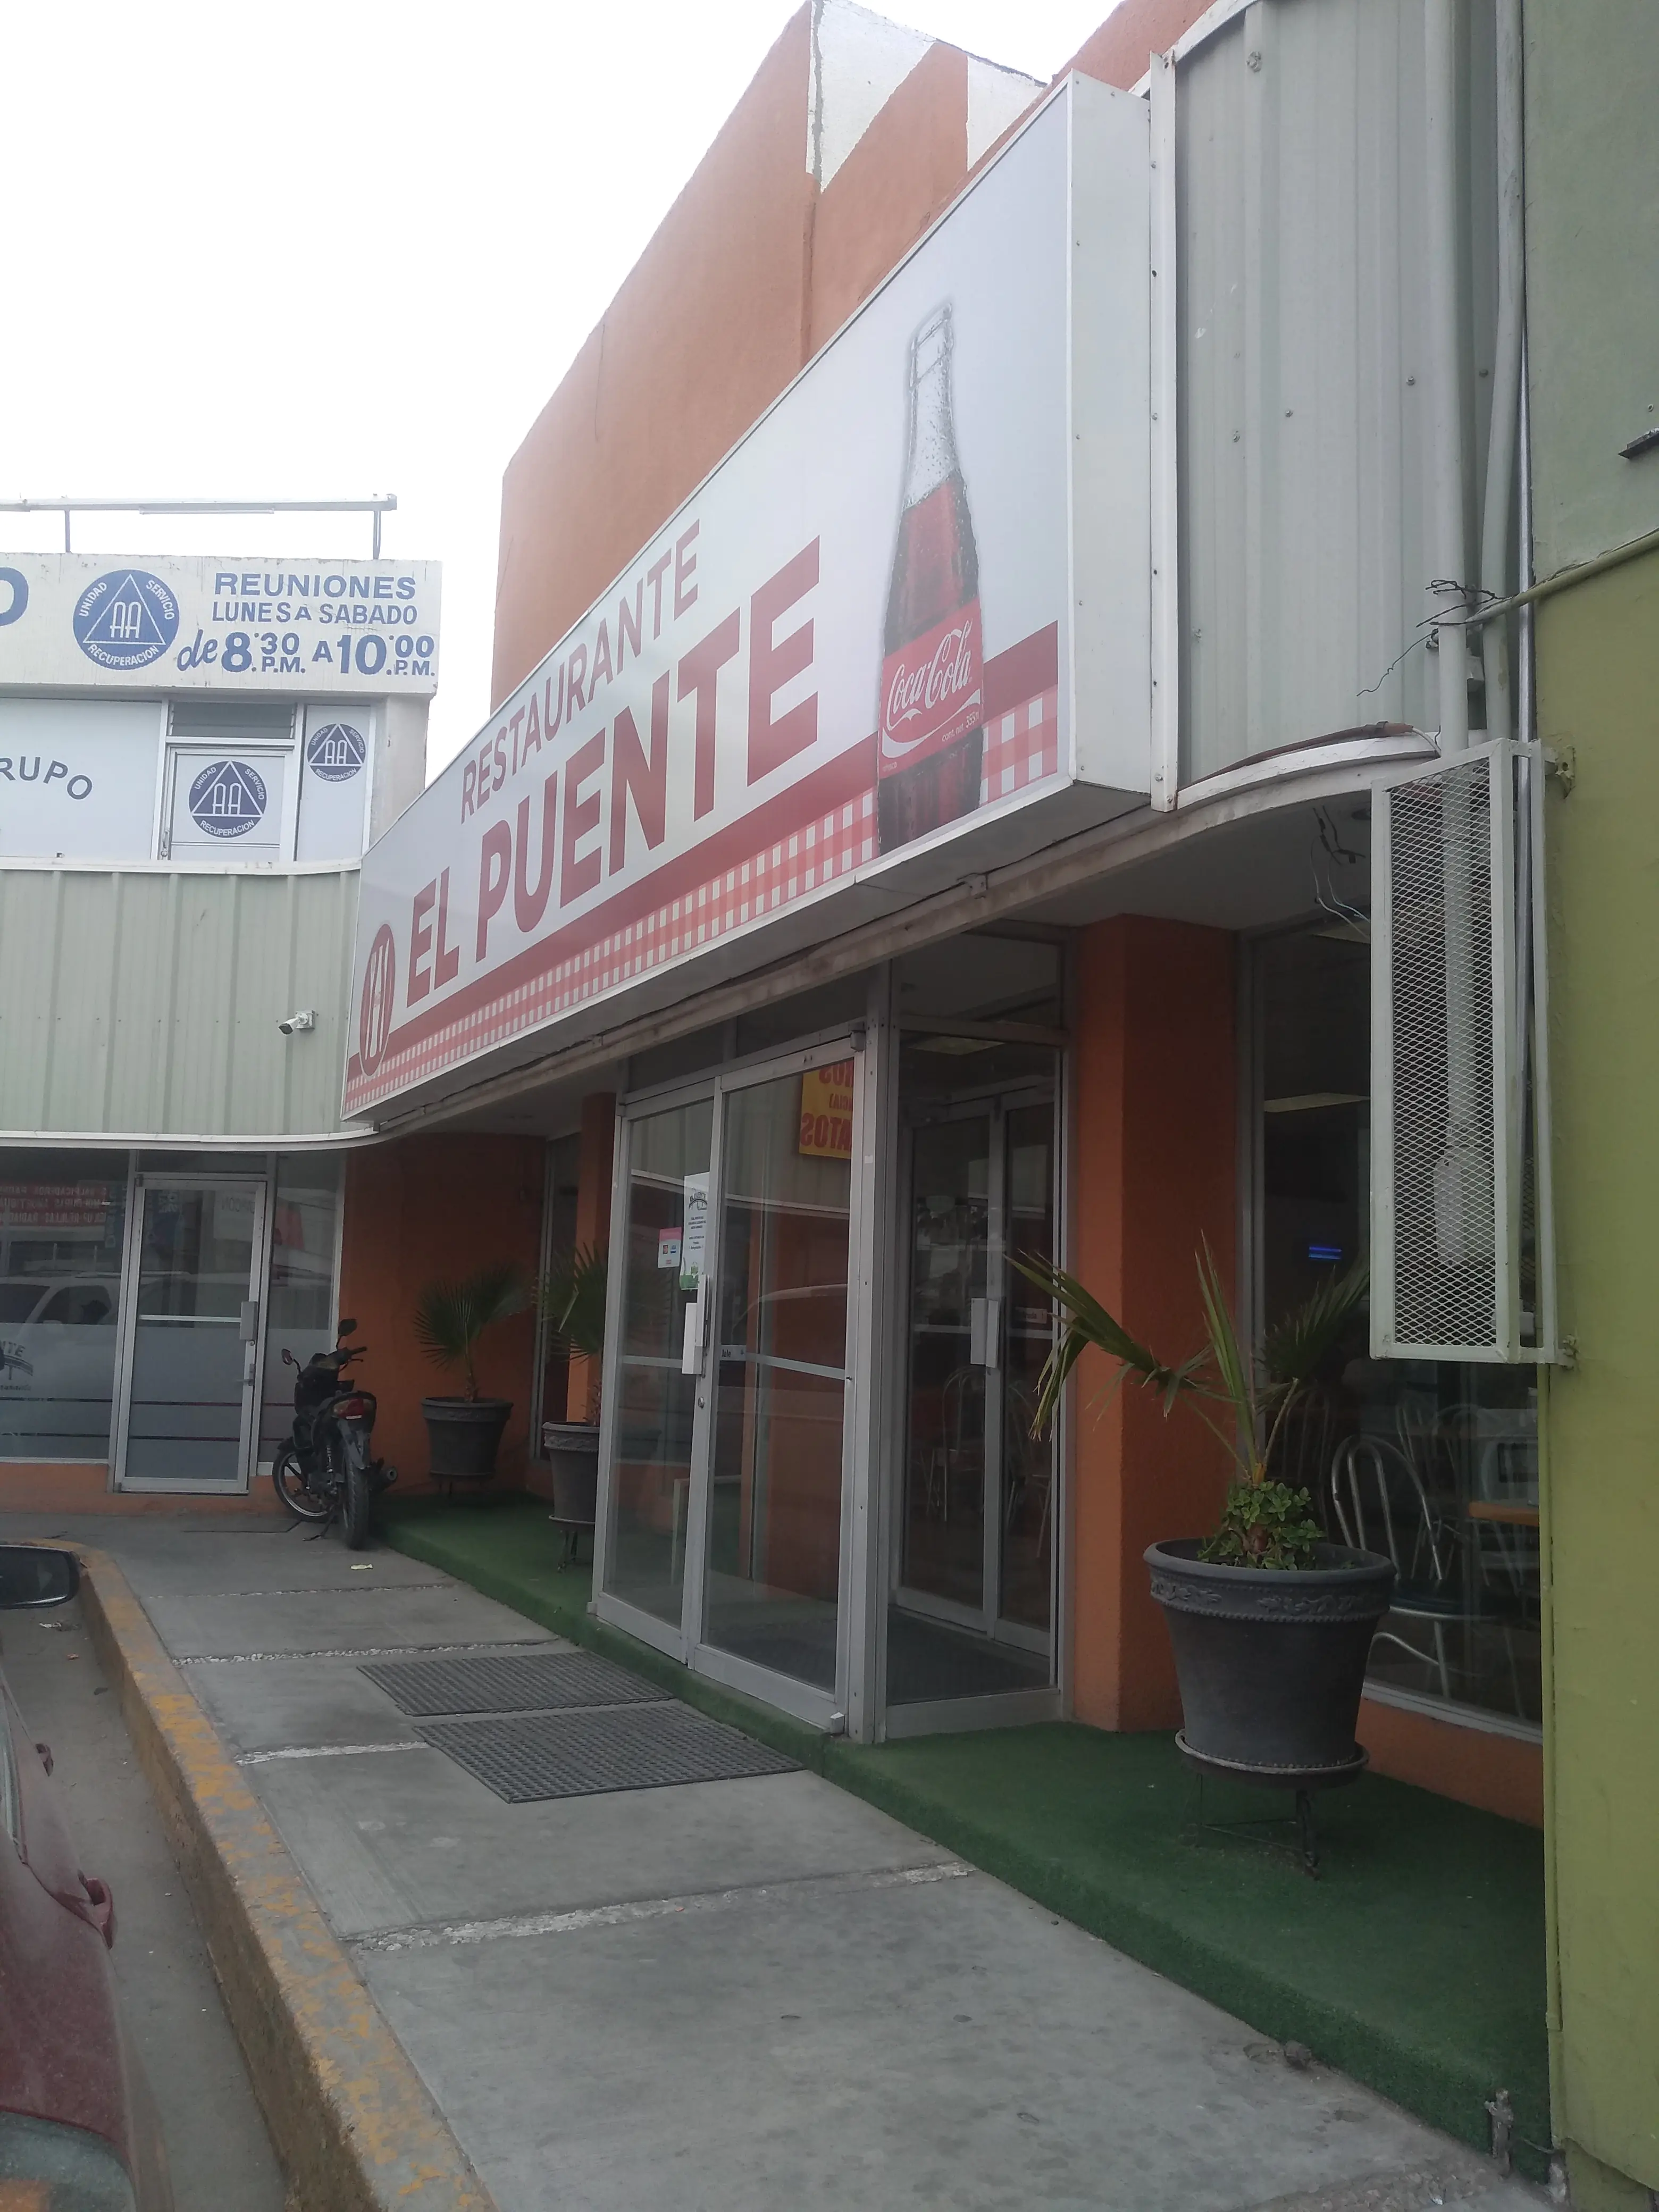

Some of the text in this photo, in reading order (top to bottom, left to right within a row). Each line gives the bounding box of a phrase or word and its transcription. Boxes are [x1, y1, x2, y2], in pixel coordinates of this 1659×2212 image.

[79, 582, 107, 617] UNIDAD
[146, 580, 175, 620] SERVICIO
[214, 572, 416, 600] REUNIONES
[110, 601, 141, 639] AA
[213, 601, 417, 625] LUNES A SABADO
[88, 644, 160, 666] RECUPERACION
[177, 629, 218, 672] de
[312, 640, 333, 663] A
[461, 518, 701, 824] RESTAURANTE
[886, 618, 973, 731] Coca-Cola
[311, 728, 328, 745] UNIDAD
[349, 729, 364, 753] SERVICIO
[325, 740, 347, 764] AA
[194, 767, 216, 790] UNIDAD
[245, 768, 264, 800] SERVICIO
[315, 768, 357, 781] RECUPERACION
[406, 534, 820, 1009] EL PUENTE
[212, 783, 241, 814] AA
[200, 819, 255, 836] RECUPERACION
